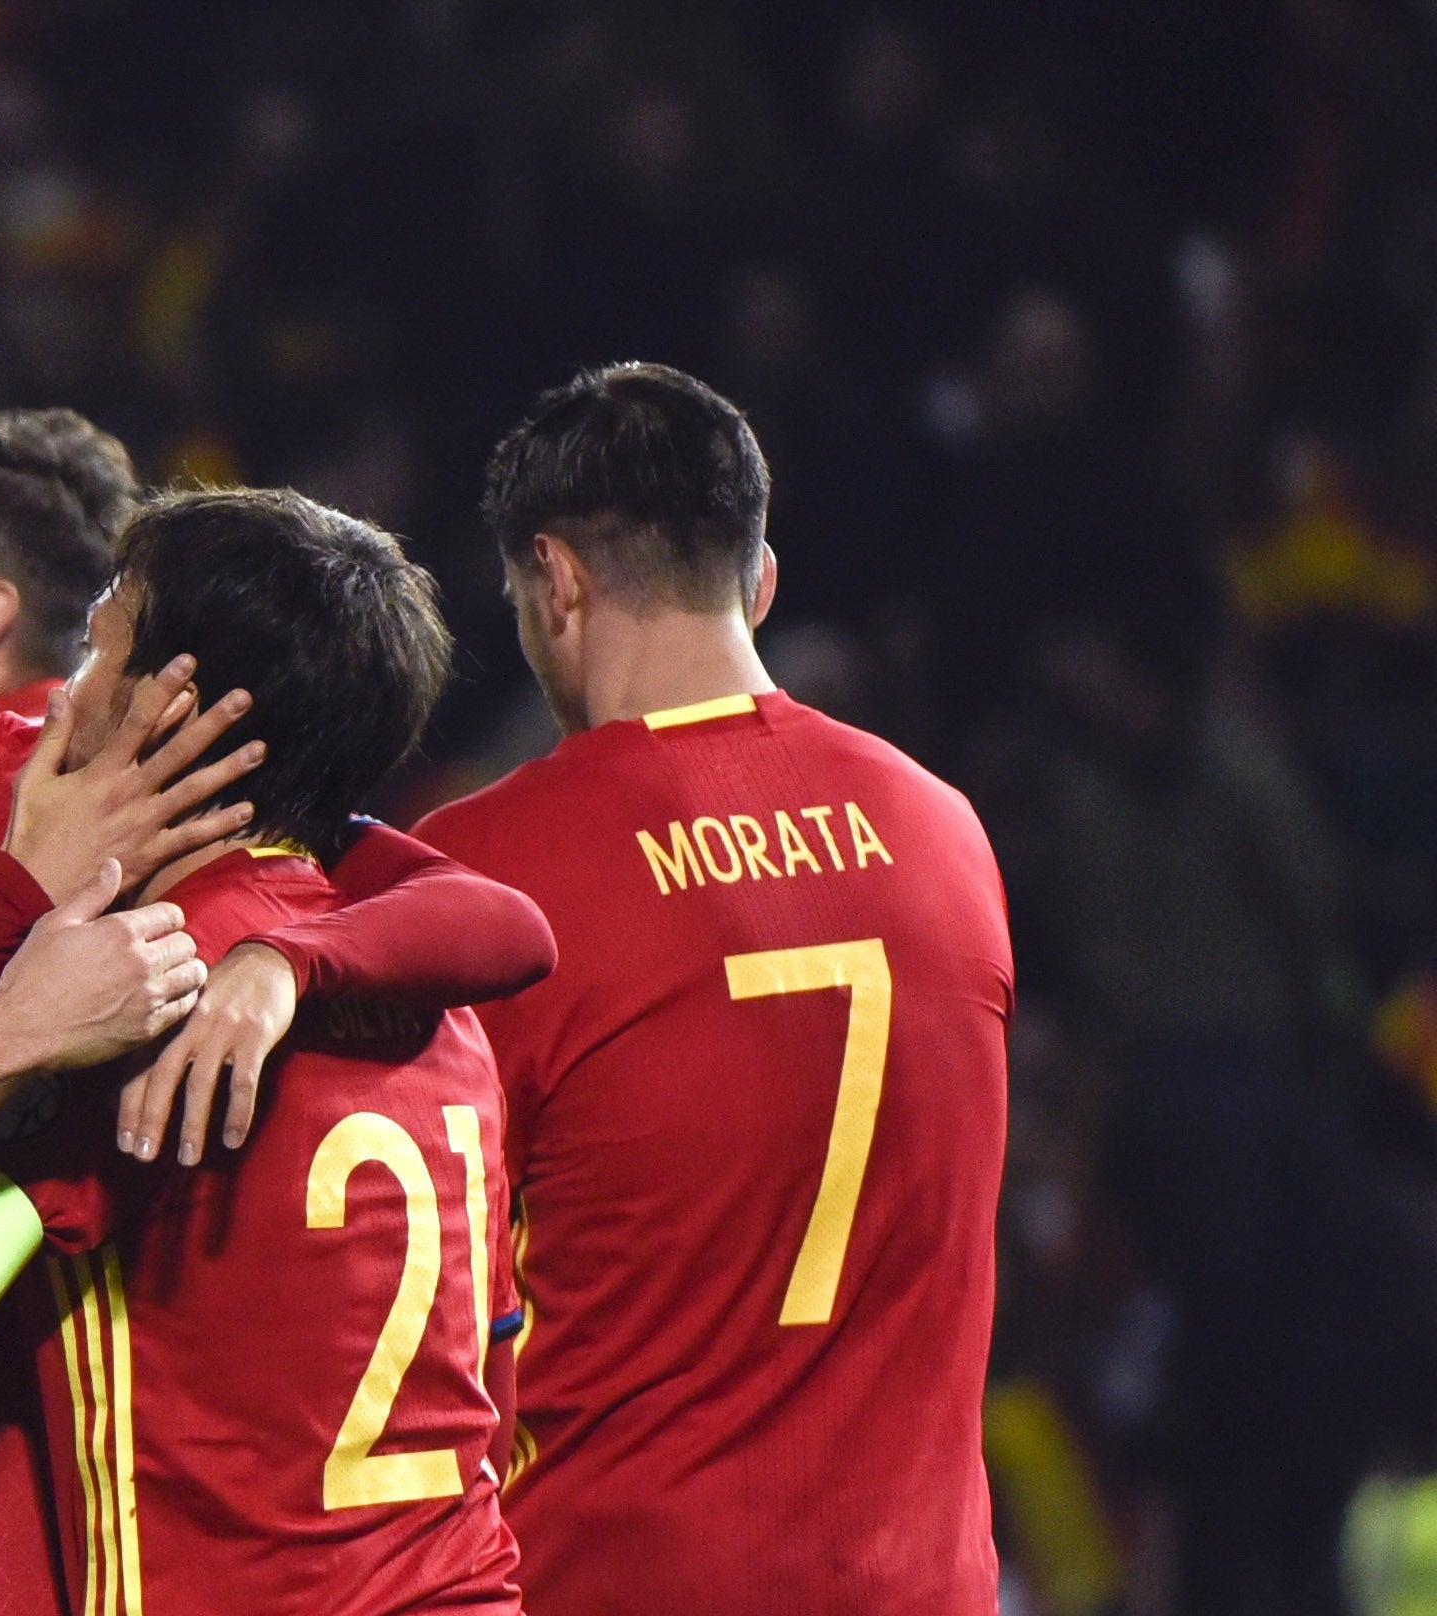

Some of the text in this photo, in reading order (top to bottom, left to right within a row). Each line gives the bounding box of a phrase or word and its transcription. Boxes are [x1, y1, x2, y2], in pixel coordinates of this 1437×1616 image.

[636, 802, 893, 895] MORATA
[306, 1105, 500, 1511] 21
[724, 938, 892, 1325] 7
